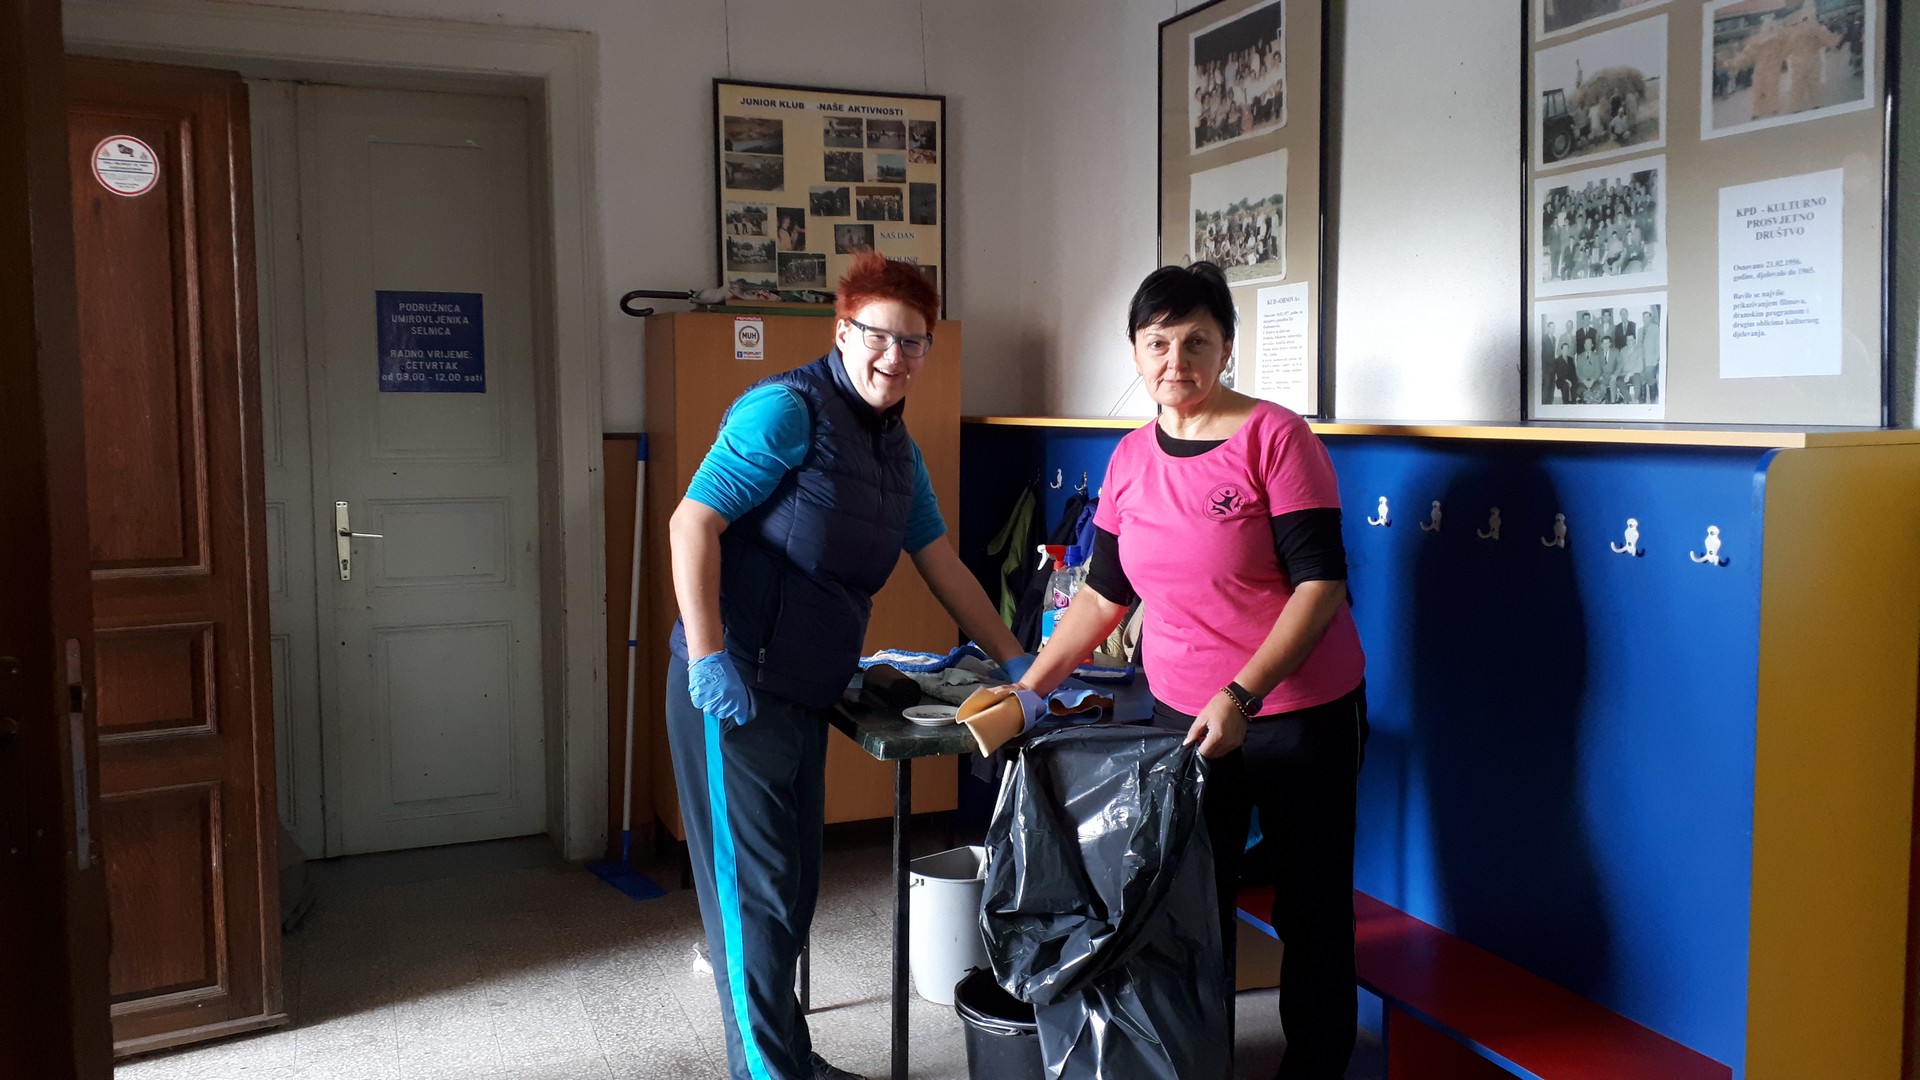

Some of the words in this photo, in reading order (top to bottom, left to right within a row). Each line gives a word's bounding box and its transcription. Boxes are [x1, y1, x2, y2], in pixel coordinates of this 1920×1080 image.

[740, 97, 776, 108] JUNIOR
[779, 101, 805, 109] KLUB
[847, 105, 904, 116] AKTIVNOSTI
[1736, 207, 1757, 217] KPD
[1747, 211, 1815, 228] PROSVJETNO
[880, 231, 896, 239] NAŠ
[897, 232, 915, 240] DAN
[1755, 226, 1805, 240] DRUŠTVO
[1733, 292, 1752, 300] Bavilo
[398, 301, 461, 313] PODRUŽNICA
[391, 314, 470, 325] UMIROVLJENIKA
[1732, 311, 1764, 319] dramskim
[1732, 321, 1756, 329] drugim
[411, 326, 452, 336] SELNICA
[742, 332, 757, 340] MUH
[390, 349, 424, 359] RADNO
[427, 350, 473, 359] VRIJEME:
[381, 373, 393, 381] od
[464, 374, 483, 382] sati
